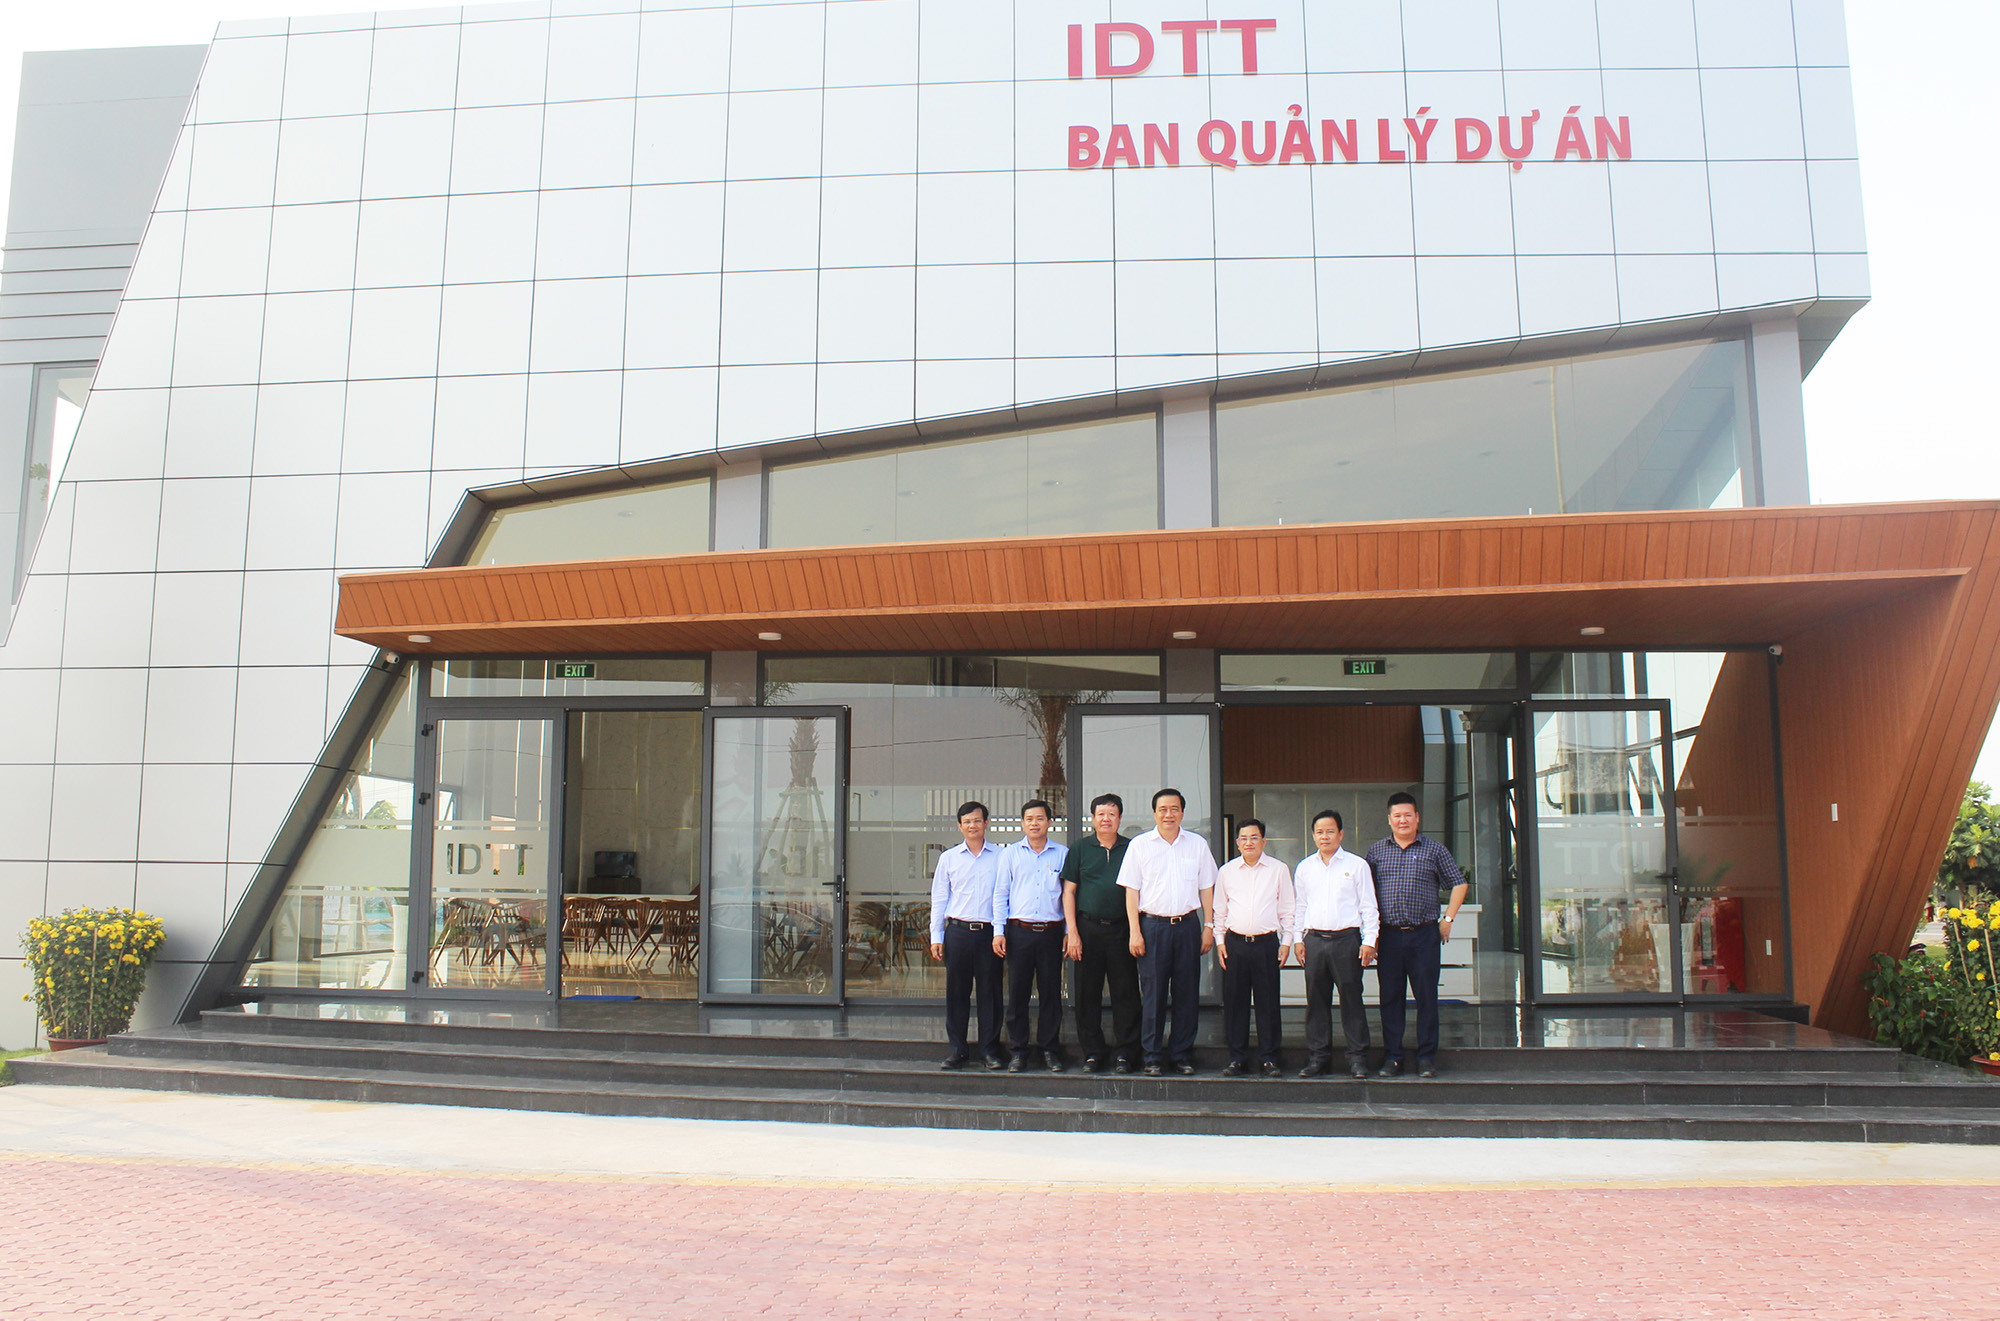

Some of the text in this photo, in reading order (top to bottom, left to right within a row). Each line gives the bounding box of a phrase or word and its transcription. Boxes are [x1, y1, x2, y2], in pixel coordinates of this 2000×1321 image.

[1067, 19, 1277, 80] IDTT
[1068, 103, 1632, 172] BAN QUẢN LÝ DỰ ÁN
[564, 664, 587, 677] EXIT
[1352, 661, 1376, 674] EXIT
[447, 843, 533, 876] IDTT
